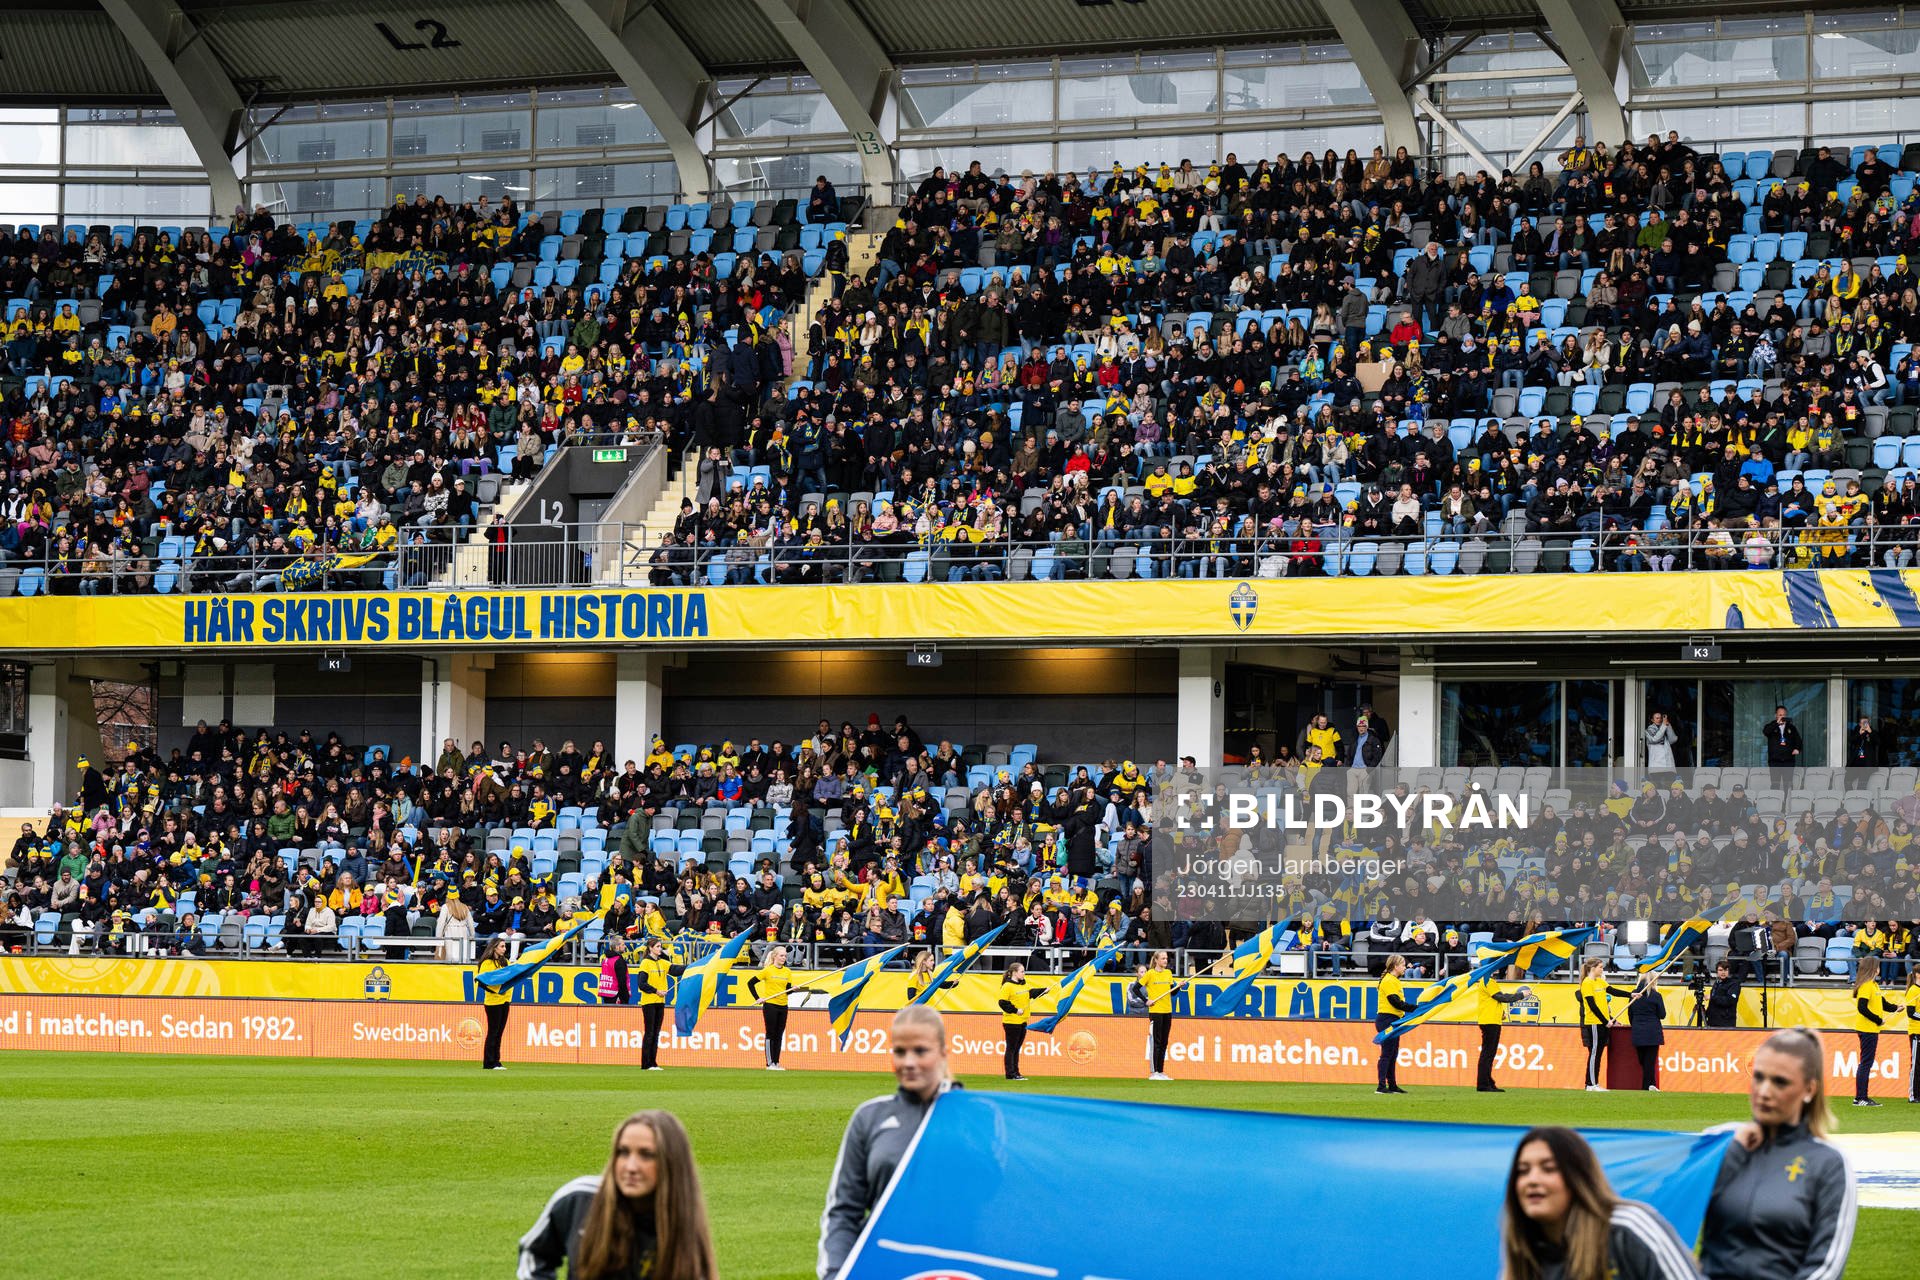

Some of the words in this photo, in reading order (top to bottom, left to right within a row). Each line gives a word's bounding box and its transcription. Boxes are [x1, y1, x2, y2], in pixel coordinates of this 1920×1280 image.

[374, 20, 462, 49] L2
[857, 131, 876, 141] L2
[862, 143, 881, 154] L3
[541, 499, 564, 528] L2
[184, 597, 254, 642] HÄR
[262, 597, 390, 642] SKRIVS
[398, 594, 532, 641] BLÅGUL
[540, 593, 708, 639] HISTORIA
[918, 654, 931, 663] K2
[1694, 648, 1709, 658] K3
[329, 660, 340, 669] K1
[26, 1010, 32, 1035] i
[40, 1013, 152, 1037] matchen.
[160, 1014, 233, 1039] Sedan
[241, 1016, 303, 1041] 1982.
[353, 1022, 452, 1043] Swedbank
[526, 1022, 581, 1048] Med
[590, 1023, 596, 1047] i
[605, 1024, 728, 1050] machen.
[952, 1034, 1062, 1056] Sweank
[1214, 1036, 1221, 1062] i
[1231, 1038, 1368, 1066] matchen.
[1396, 1041, 1468, 1069] edan
[1478, 1043, 1553, 1071] 982.
